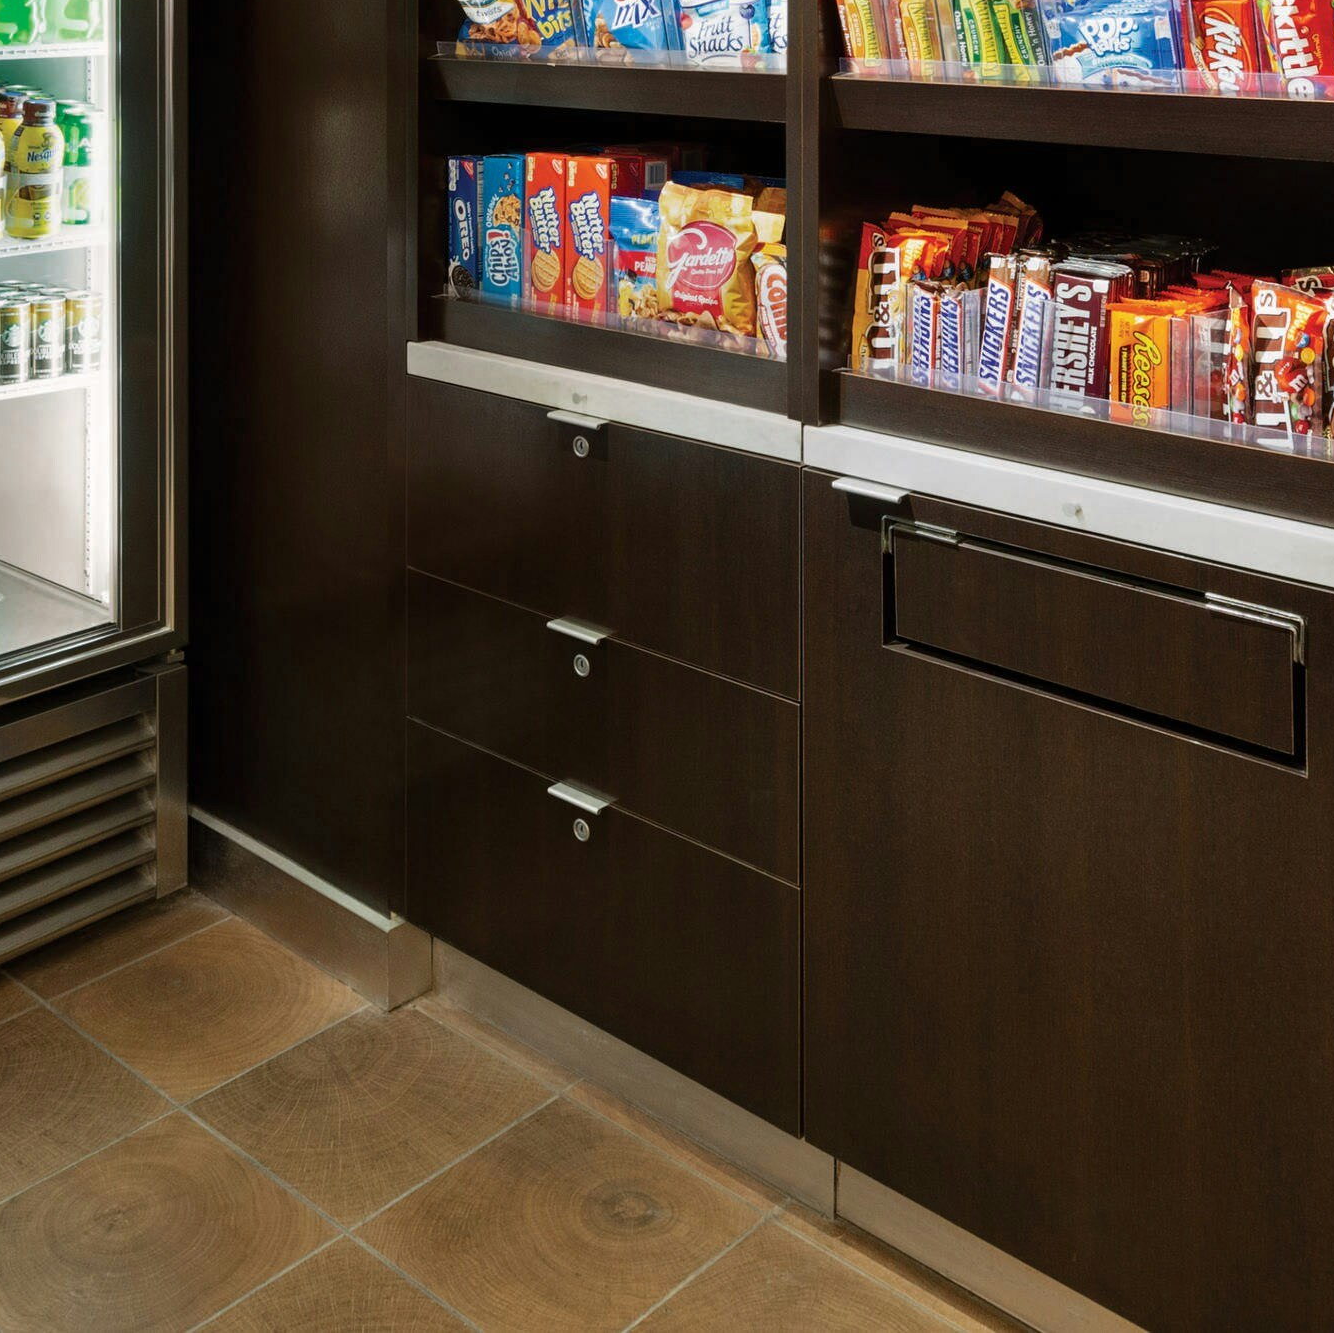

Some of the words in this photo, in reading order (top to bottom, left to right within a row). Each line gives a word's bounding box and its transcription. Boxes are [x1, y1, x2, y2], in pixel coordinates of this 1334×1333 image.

[689, 32, 744, 55] Snacks
[697, 16, 733, 41] Fruit
[979, 282, 1010, 386] SNICKERS
[1016, 282, 1049, 388] SNICKERS
